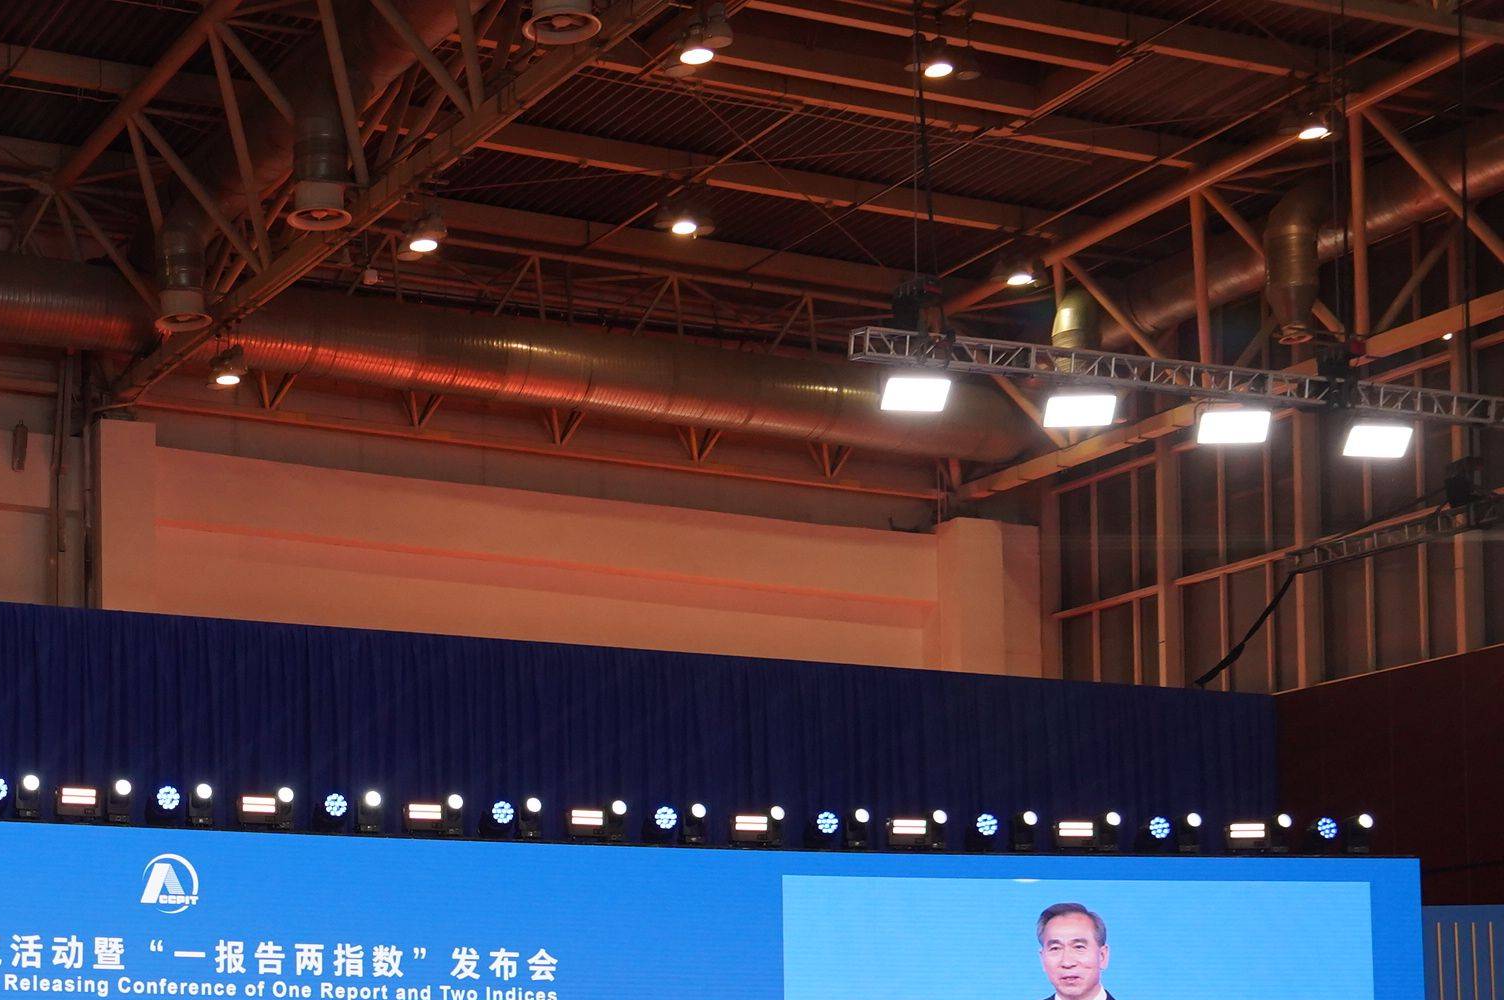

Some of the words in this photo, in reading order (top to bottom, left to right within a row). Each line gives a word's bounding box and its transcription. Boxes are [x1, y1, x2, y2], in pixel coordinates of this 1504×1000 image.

[4, 974, 109, 997] Releasing
[118, 976, 236, 997] Conference
[245, 981, 265, 998] of
[272, 981, 312, 998] One
[396, 985, 431, 1000] and
